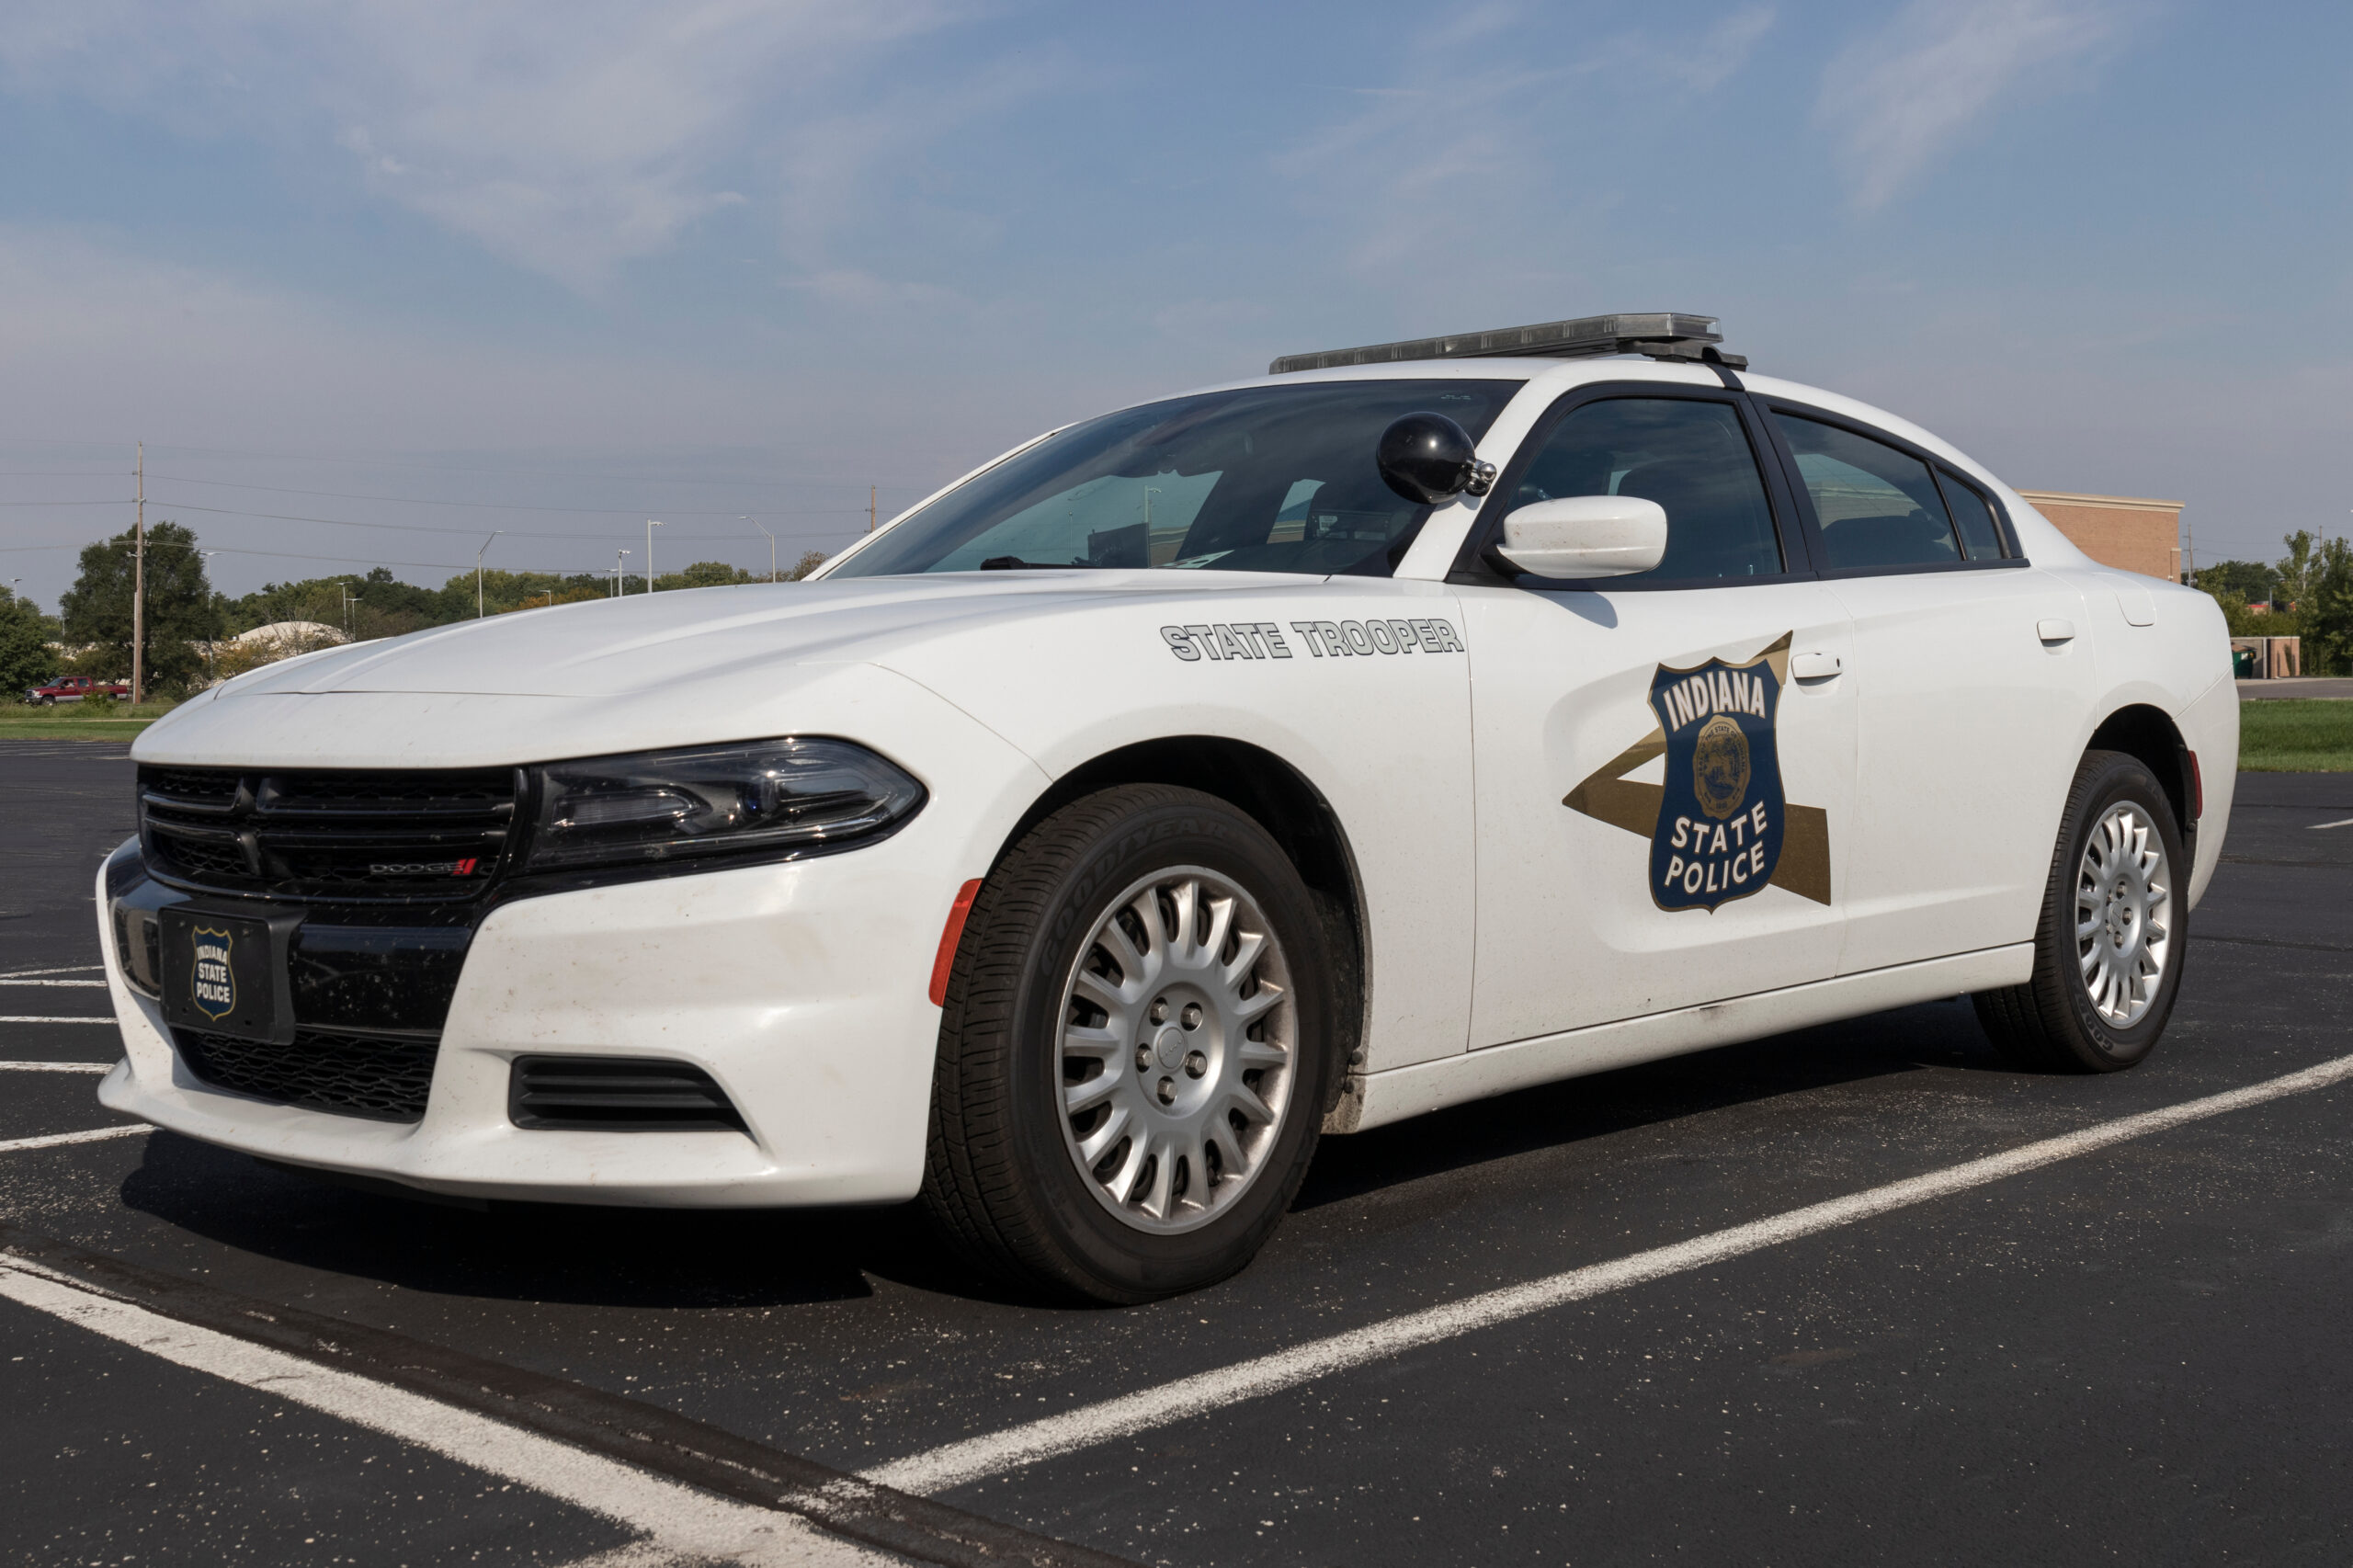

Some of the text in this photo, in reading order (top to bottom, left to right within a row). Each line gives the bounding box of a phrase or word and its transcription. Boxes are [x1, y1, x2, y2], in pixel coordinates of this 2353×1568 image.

[1160, 619, 1465, 662] STATE TROOPER
[1663, 670, 1767, 733] INDIANA
[1714, 725, 1730, 733] STATE
[1670, 801, 1768, 855] STATE
[369, 862, 464, 874] DODGE
[1664, 842, 1766, 894] POLICE
[1041, 817, 1228, 976] GOODYEAR
[197, 945, 228, 965] INDIANA
[199, 963, 227, 983] STATE
[196, 982, 231, 1004] POLICE
